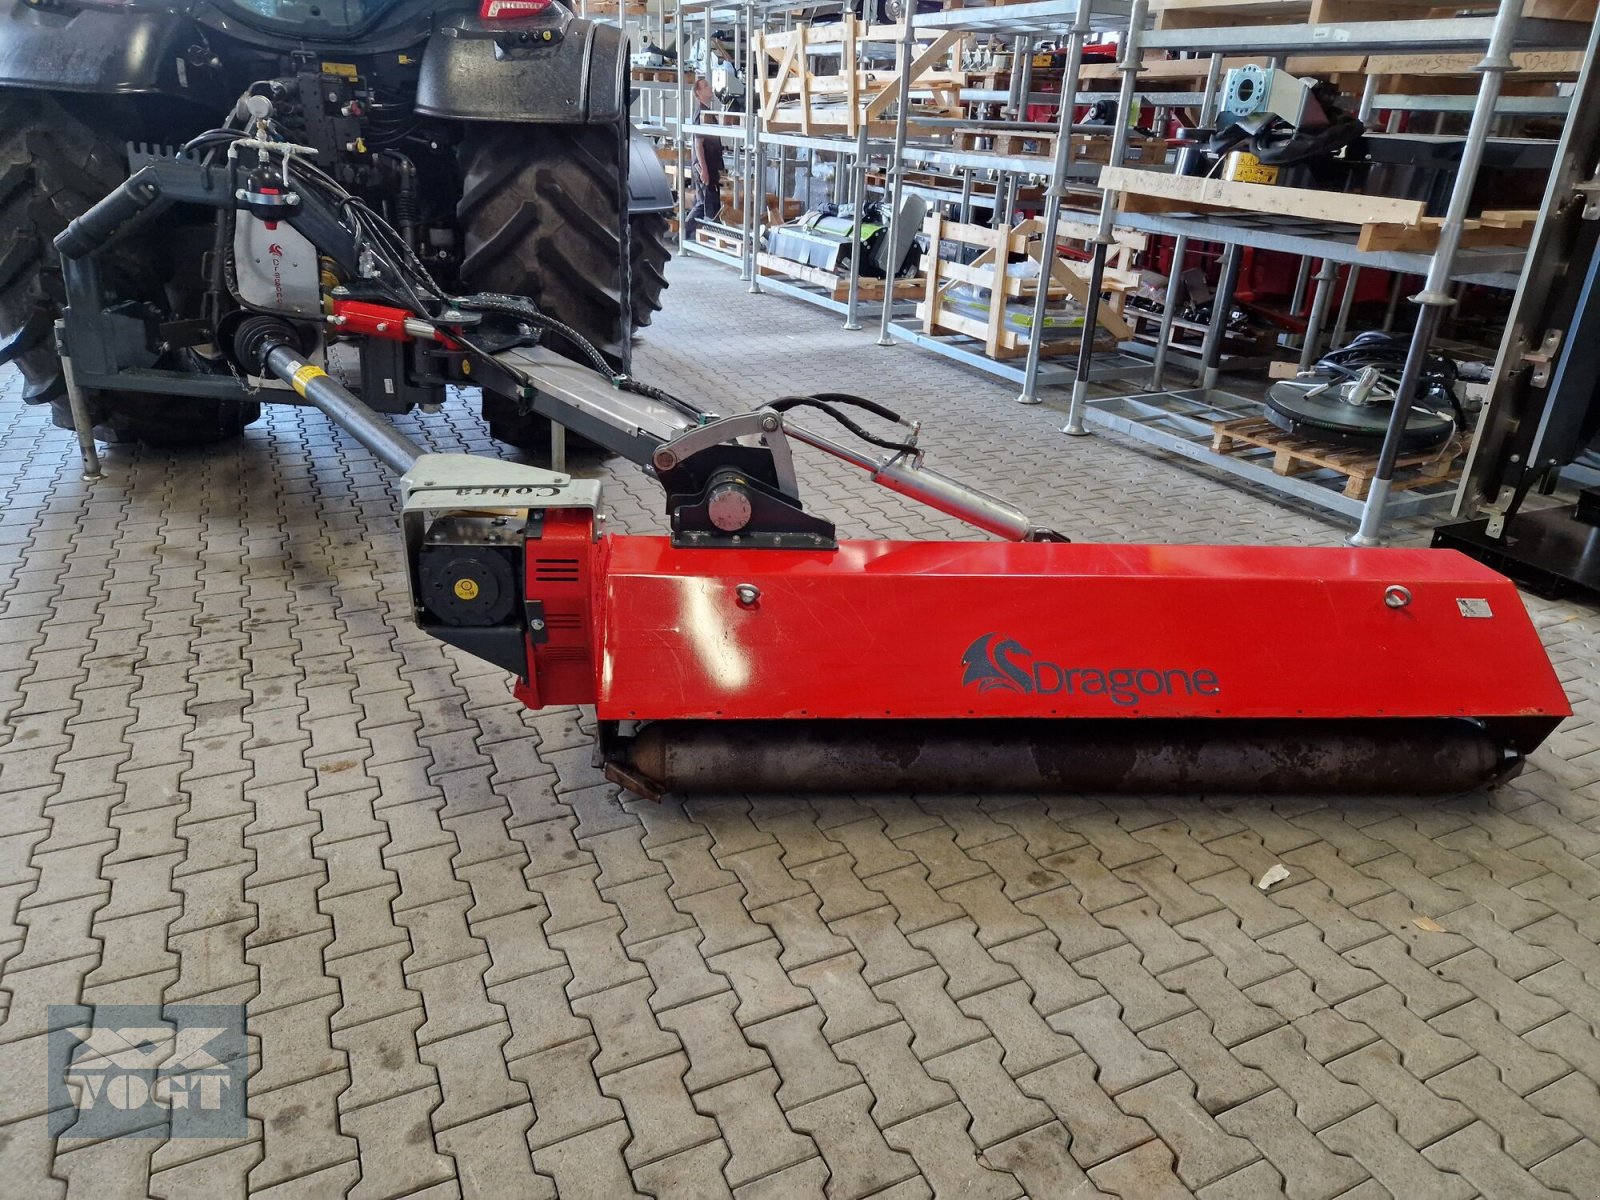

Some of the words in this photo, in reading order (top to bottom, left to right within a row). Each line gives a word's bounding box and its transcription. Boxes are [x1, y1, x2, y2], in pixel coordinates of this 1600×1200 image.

[272, 258, 283, 304] Dragone
[455, 486, 561, 497] Cobra
[1032, 661, 1219, 706] Dragone
